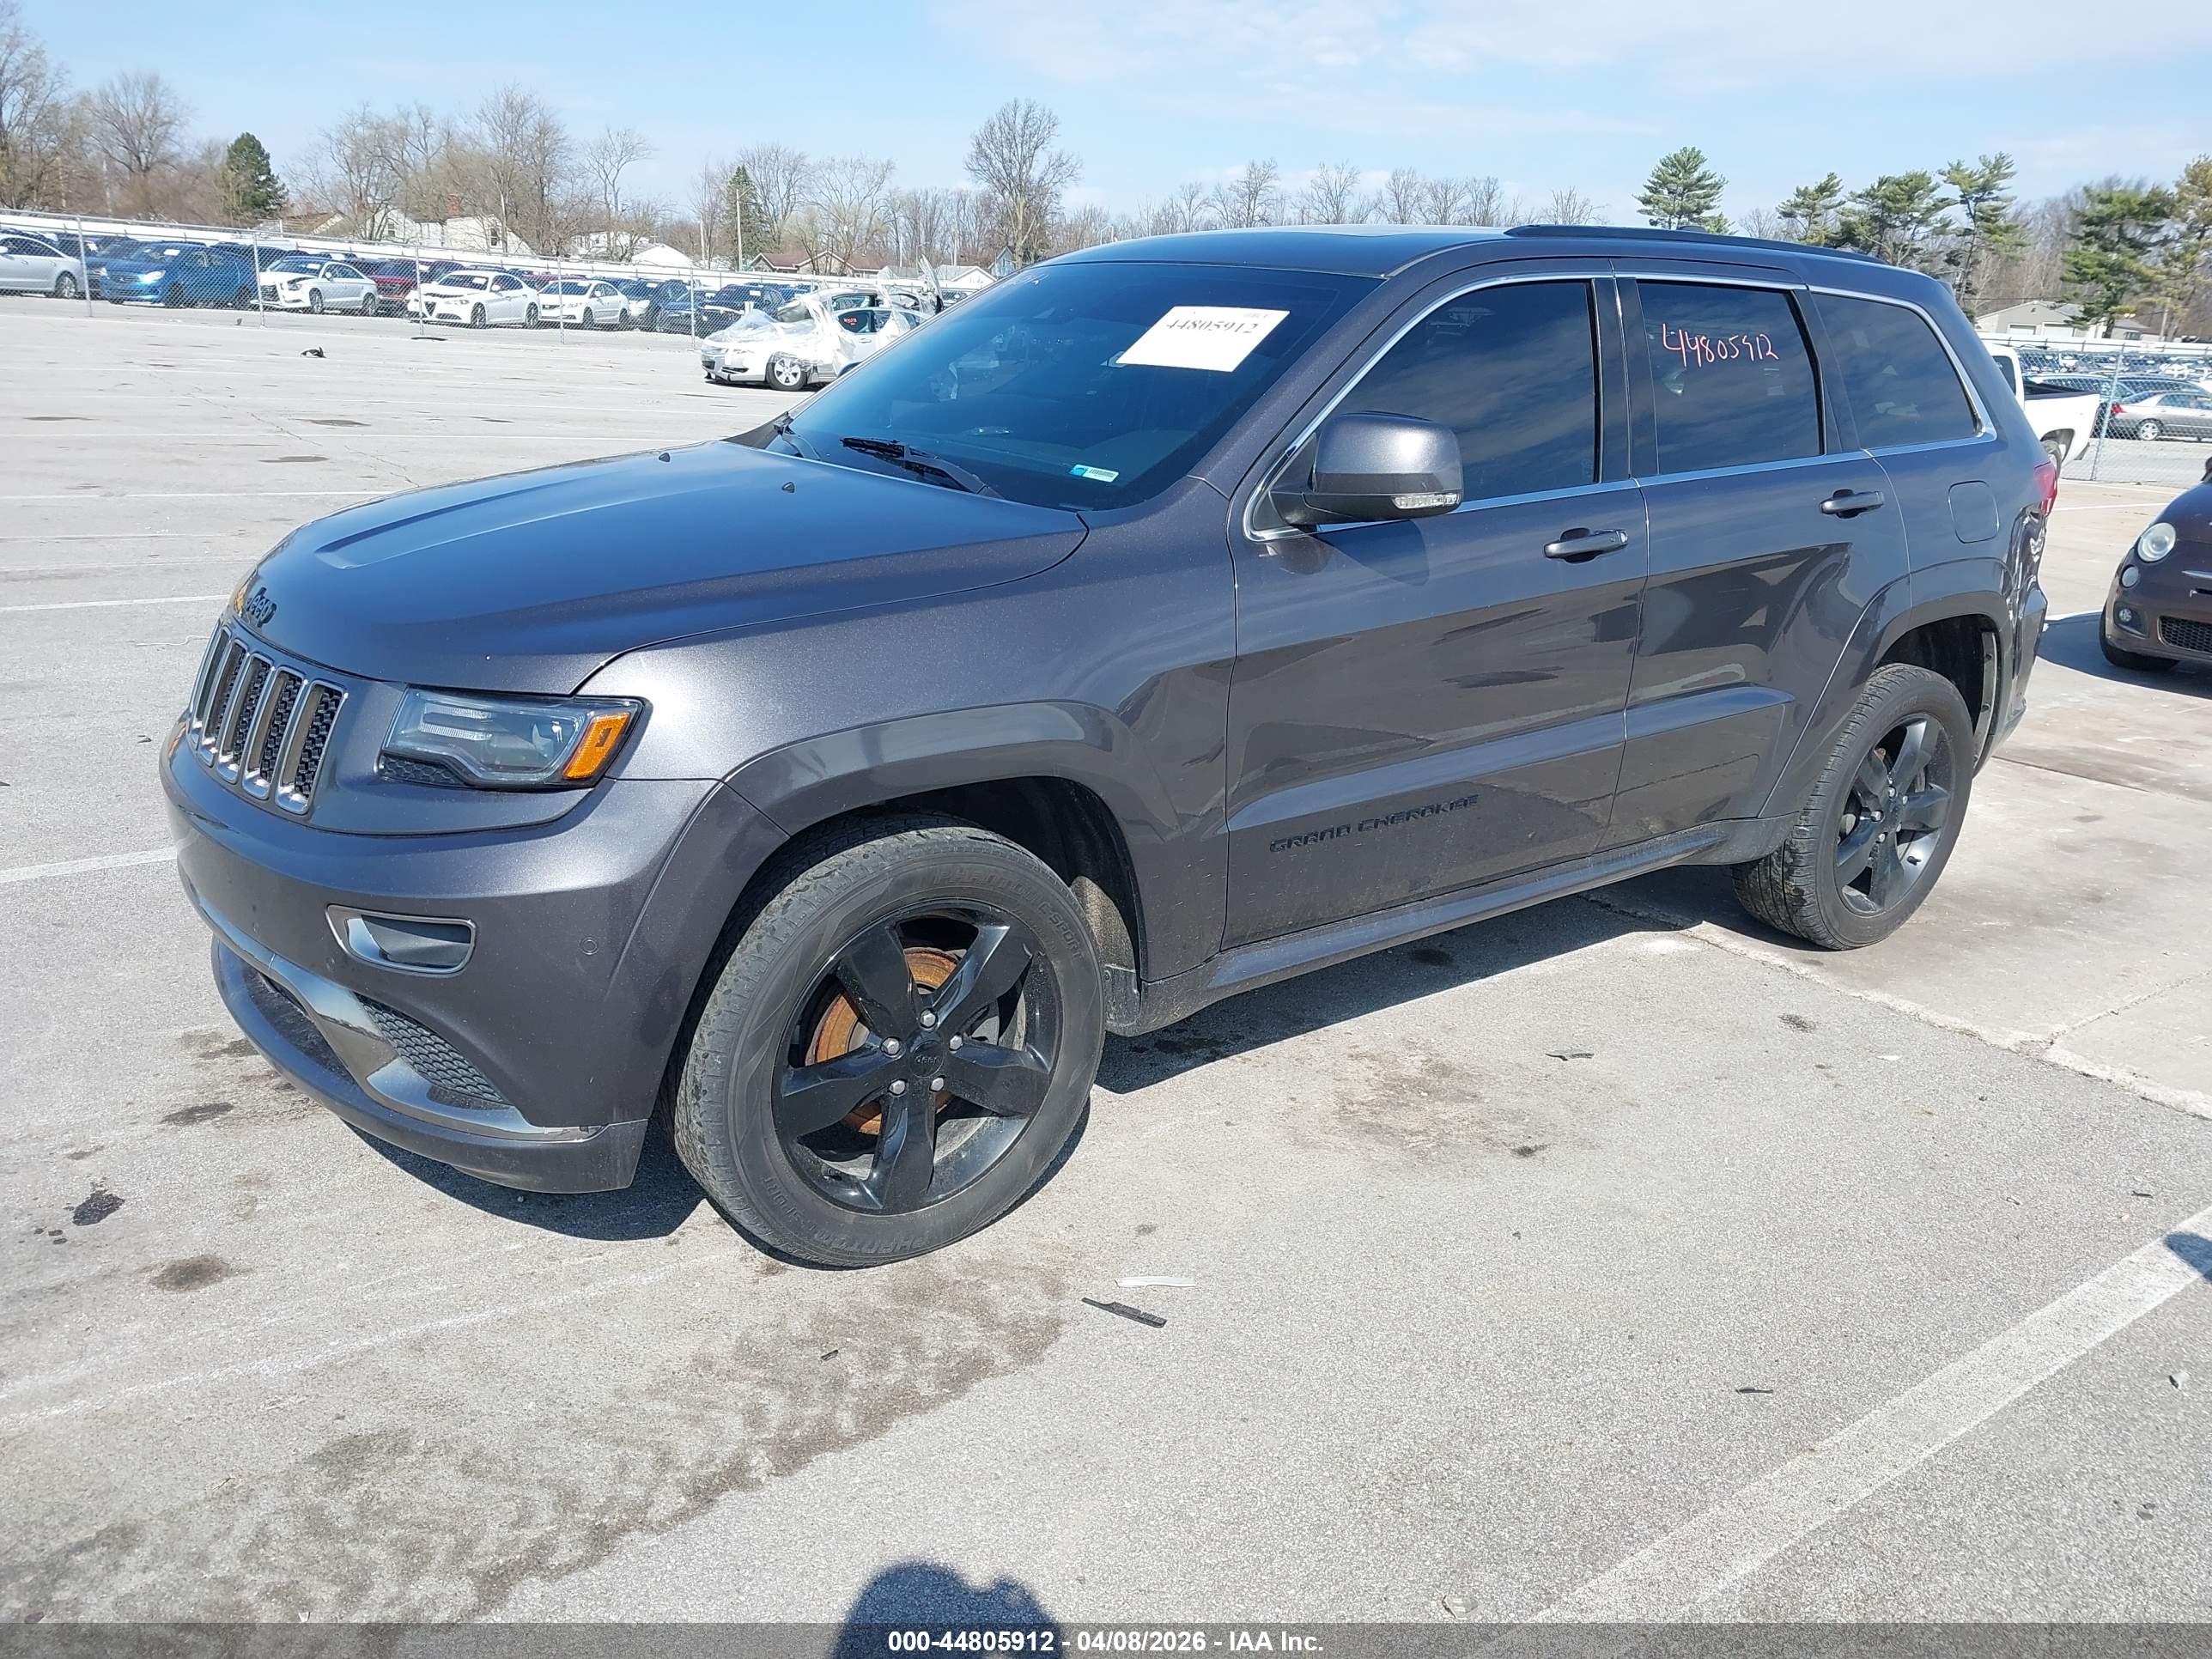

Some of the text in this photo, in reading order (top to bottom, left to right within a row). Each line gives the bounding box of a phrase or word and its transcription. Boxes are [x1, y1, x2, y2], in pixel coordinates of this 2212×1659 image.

[1166, 319, 1259, 334] 44805912
[1662, 322, 1780, 368] 44805912
[1269, 793, 1480, 854] GRAND CHEROKEE
